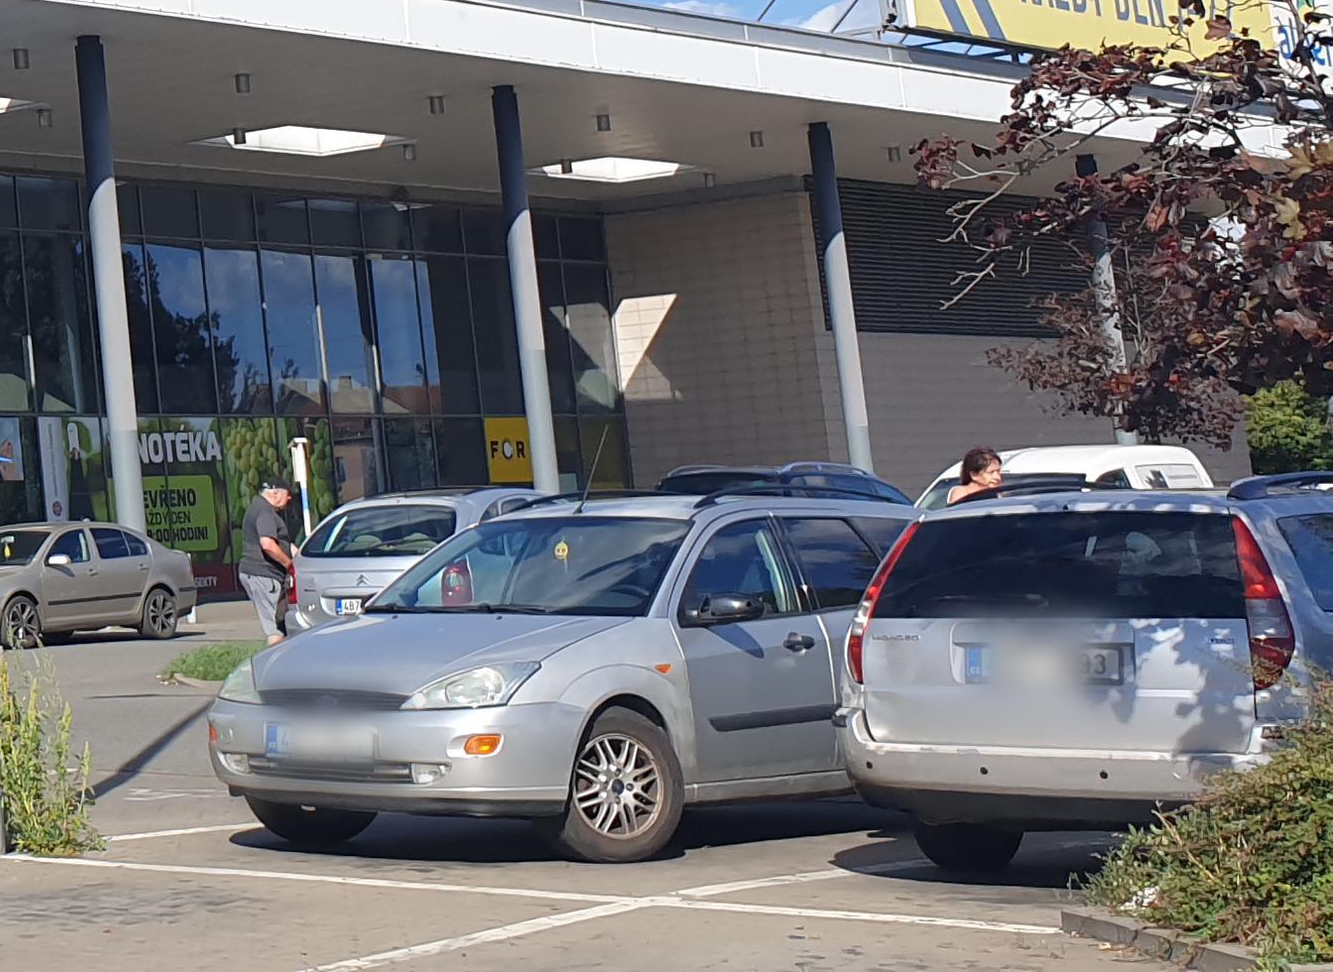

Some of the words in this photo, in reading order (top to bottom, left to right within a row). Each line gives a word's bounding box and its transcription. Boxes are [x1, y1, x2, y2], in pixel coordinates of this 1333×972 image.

[137, 424, 222, 464] NOTÉKA
[143, 484, 196, 509] EVŘENO
[171, 511, 191, 524] DEN
